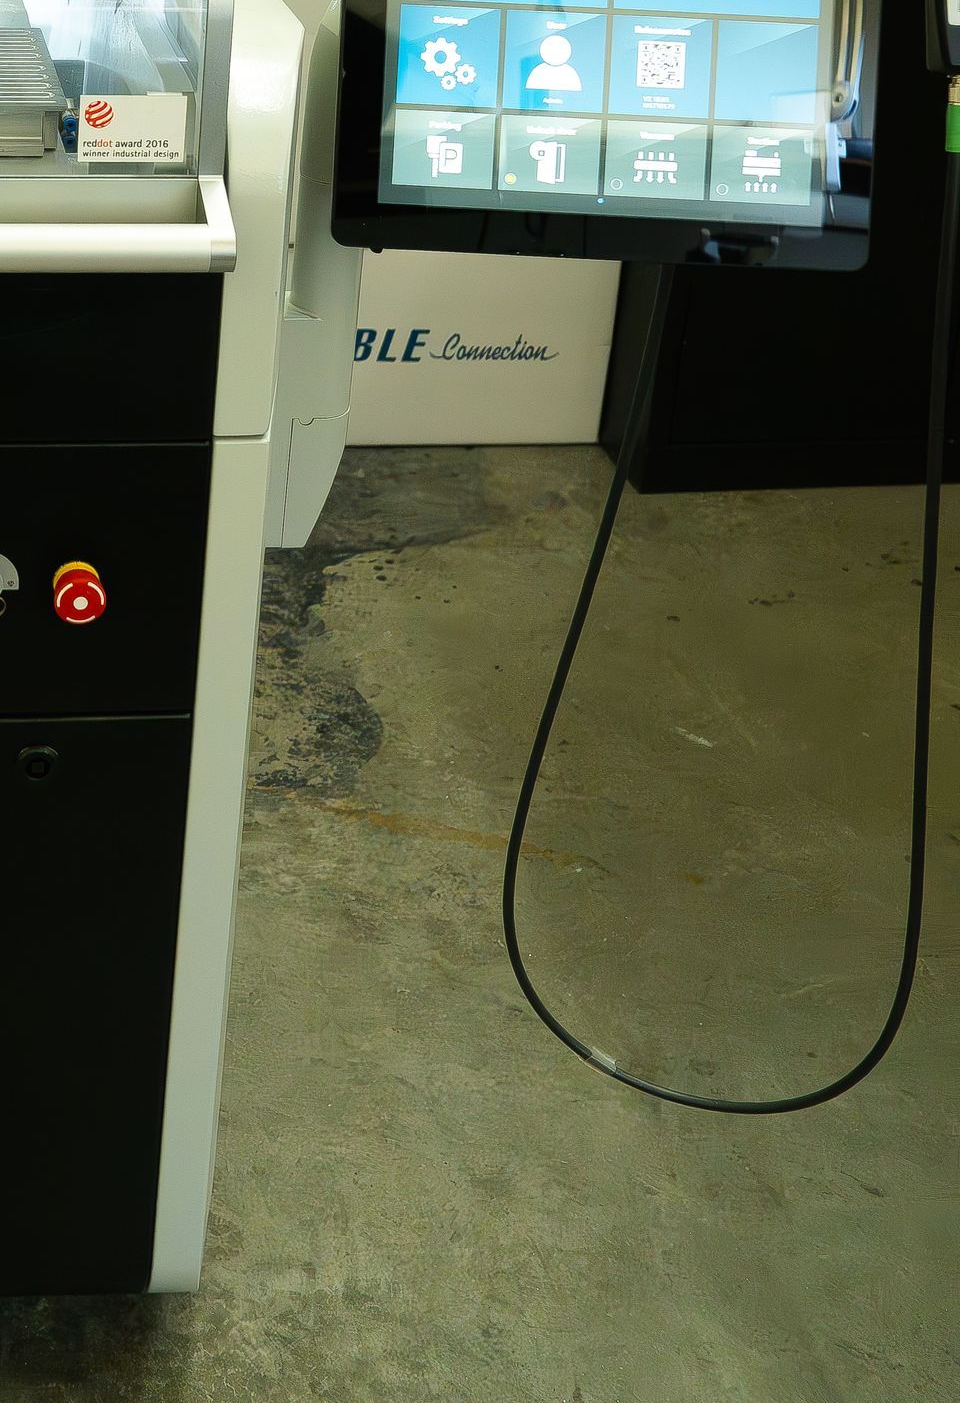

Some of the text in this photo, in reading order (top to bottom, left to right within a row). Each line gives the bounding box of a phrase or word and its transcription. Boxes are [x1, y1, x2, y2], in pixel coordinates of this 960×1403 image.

[432, 15, 469, 26] Settings
[82, 139, 169, 148] reddot award 2016
[82, 150, 180, 159] winner industrial design
[429, 333, 559, 361] Connection
